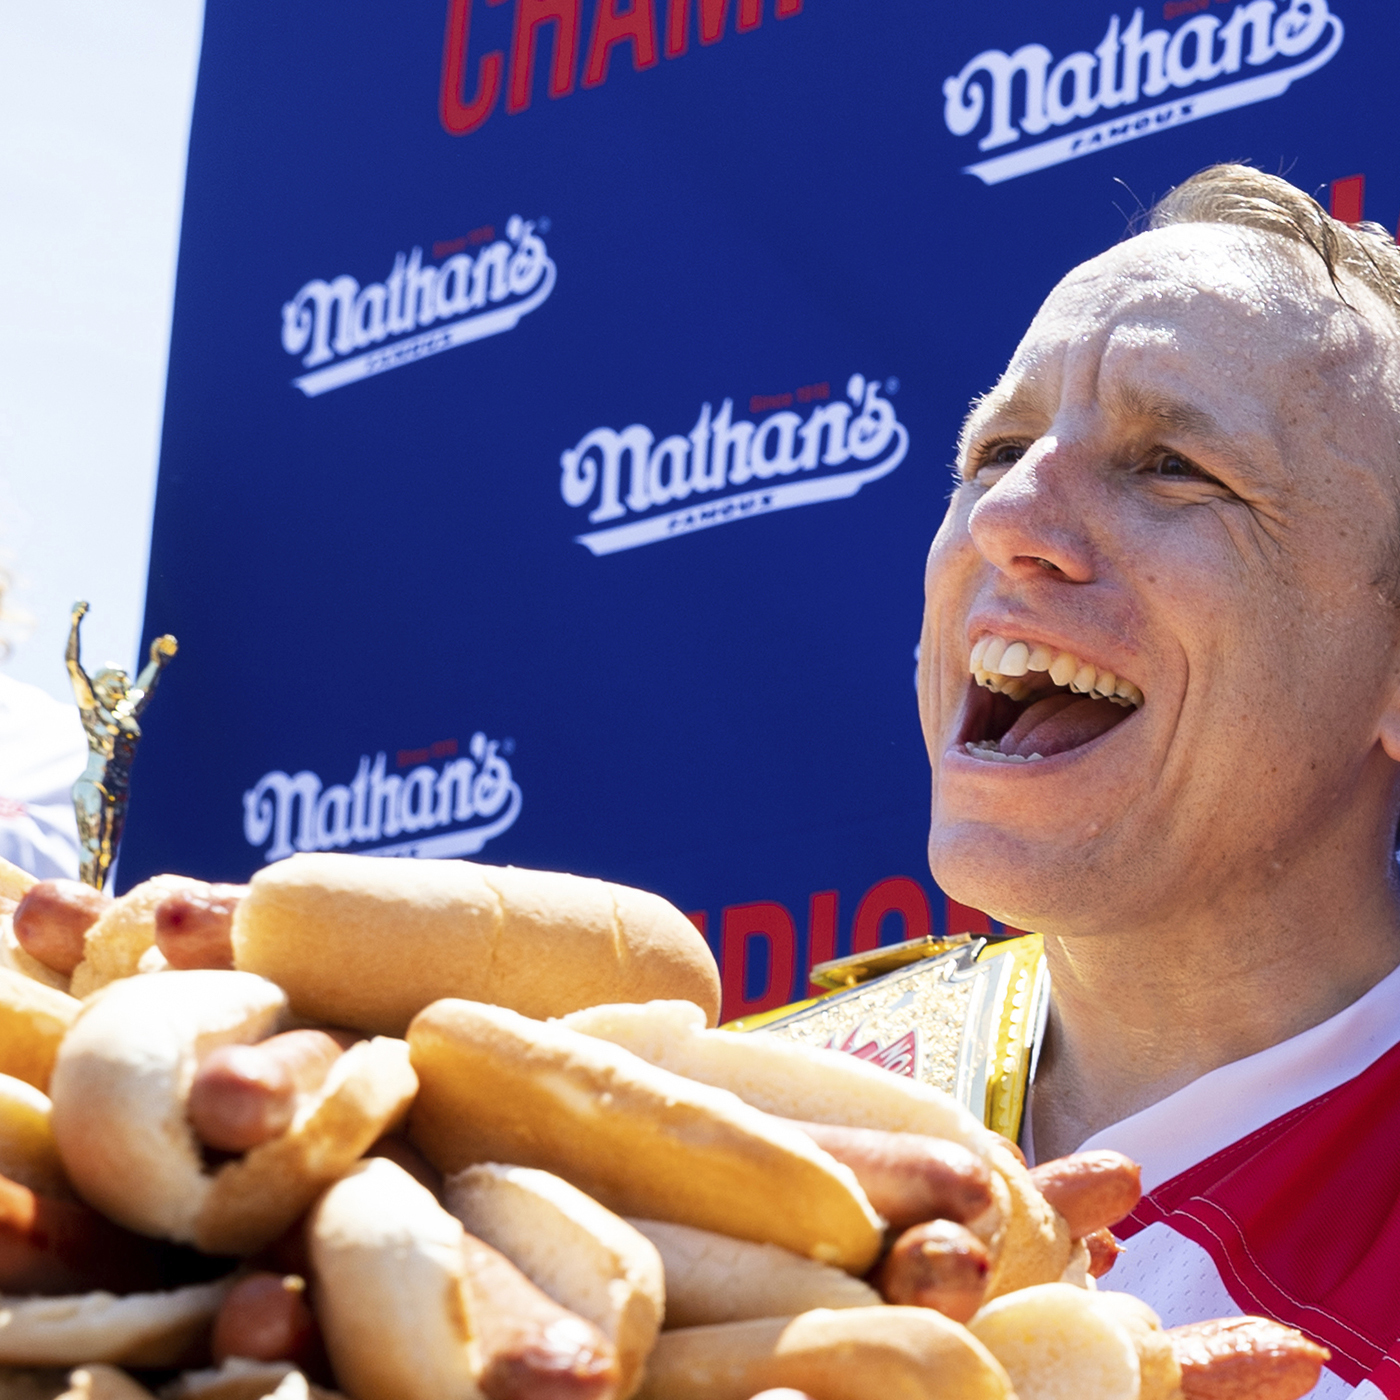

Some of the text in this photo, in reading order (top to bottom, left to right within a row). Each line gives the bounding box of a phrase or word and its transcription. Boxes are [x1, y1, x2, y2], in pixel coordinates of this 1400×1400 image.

[943, 0, 1330, 152] Nathans
[281, 214, 547, 369] Nathan's
[560, 373, 896, 524] Nathan's
[243, 732, 511, 863] Nathan's
